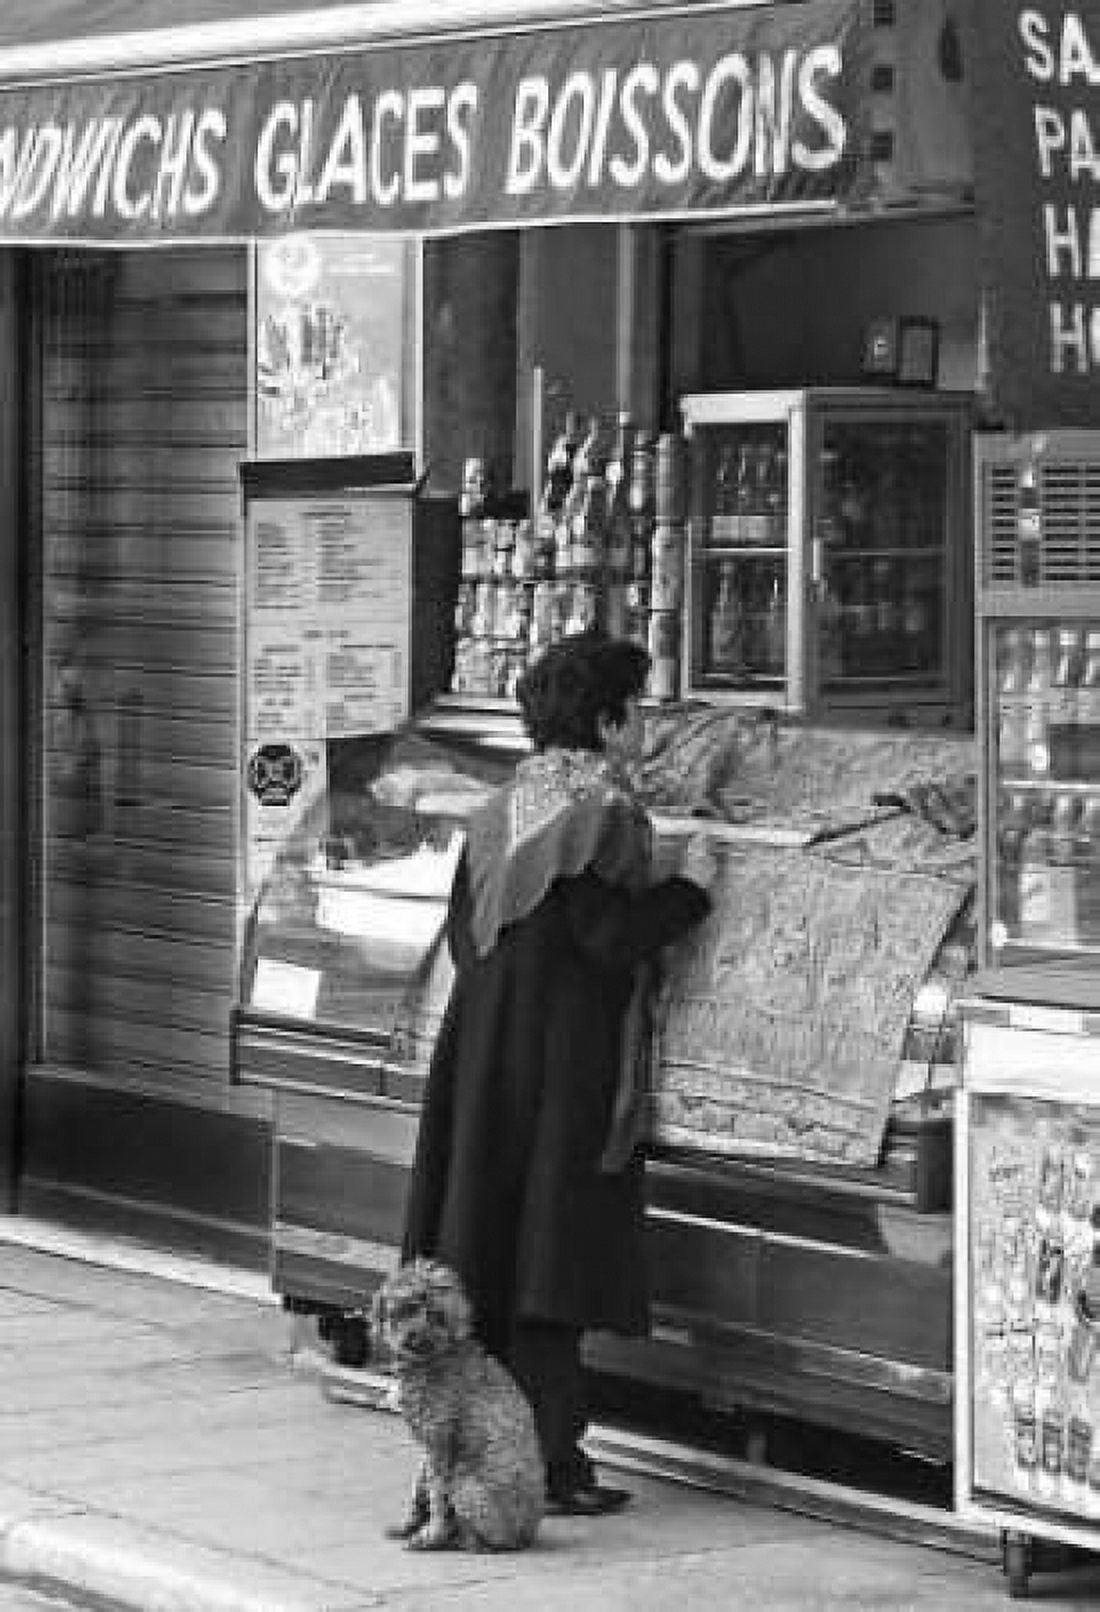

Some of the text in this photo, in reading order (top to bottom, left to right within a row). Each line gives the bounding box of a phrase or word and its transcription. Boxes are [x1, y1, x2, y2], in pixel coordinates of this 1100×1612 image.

[254, 81, 479, 212] GLACES
[505, 44, 848, 195] BOISSONS
[1051, 302, 1100, 374] H
